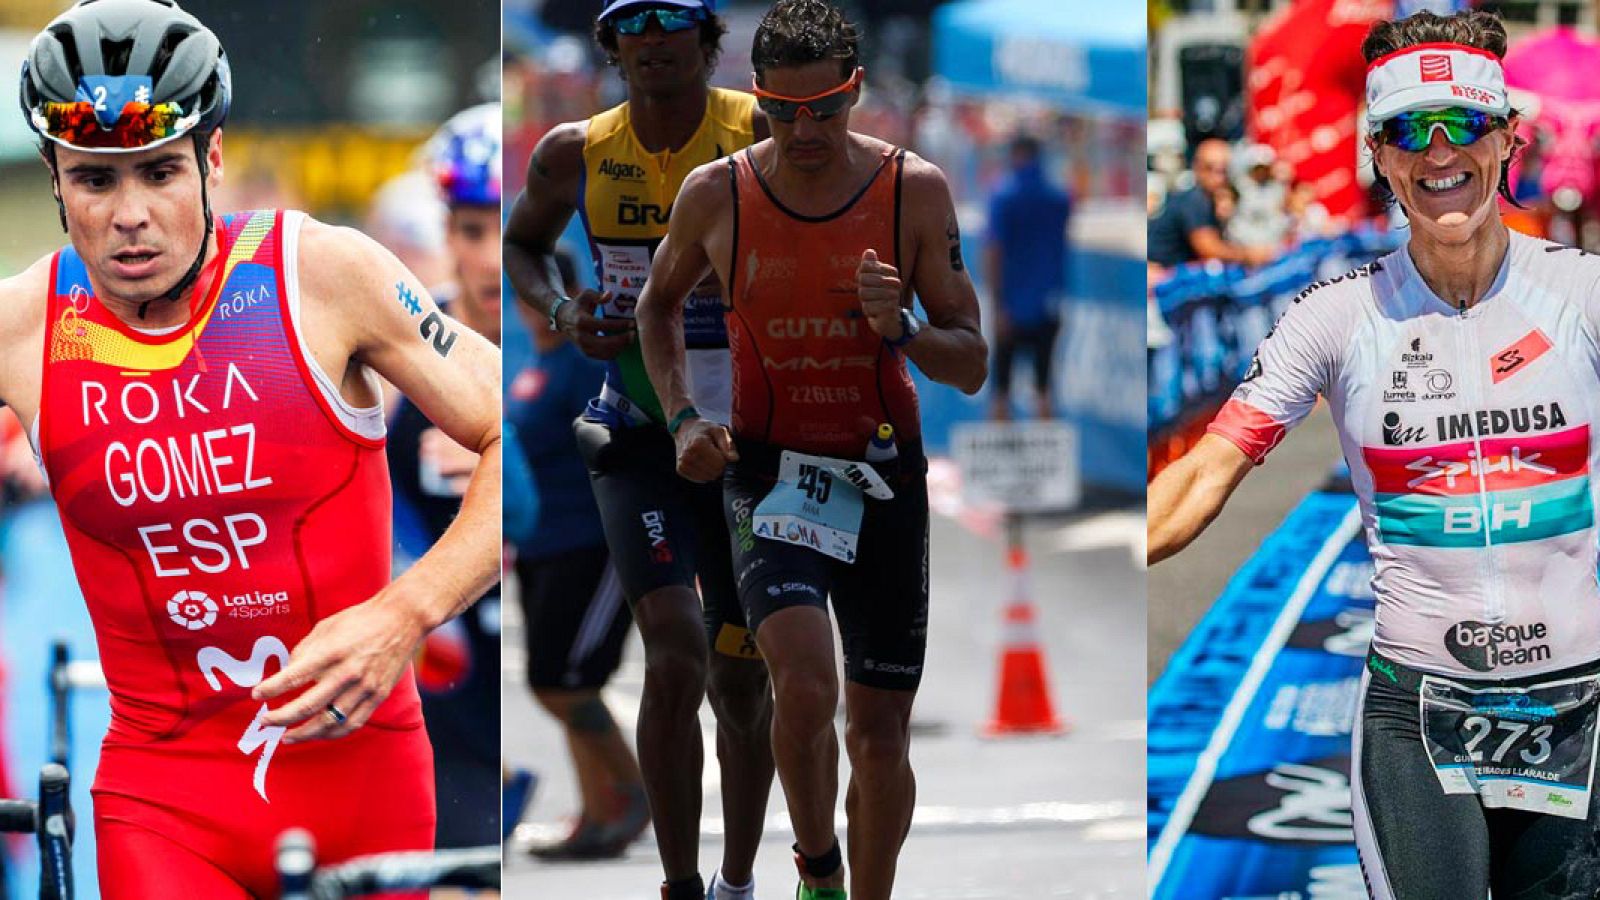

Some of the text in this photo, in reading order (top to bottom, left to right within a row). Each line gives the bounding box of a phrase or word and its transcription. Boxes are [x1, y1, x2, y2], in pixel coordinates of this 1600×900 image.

[94, 86, 107, 111] 2
[766, 317, 859, 339] GUTAI
[1401, 352, 1434, 363] Bizkaia
[786, 385, 862, 405] 226ERS
[1436, 401, 1567, 442] IMEDUSA
[104, 422, 273, 508] GOMEZ
[1443, 499, 1532, 535] BH
[137, 512, 268, 578] ESP
[223, 590, 289, 608] LaLiga
[228, 602, 290, 620] 4Sports
[1455, 620, 1547, 648] basque
[1485, 643, 1552, 669] team
[1463, 715, 1554, 766] 273
